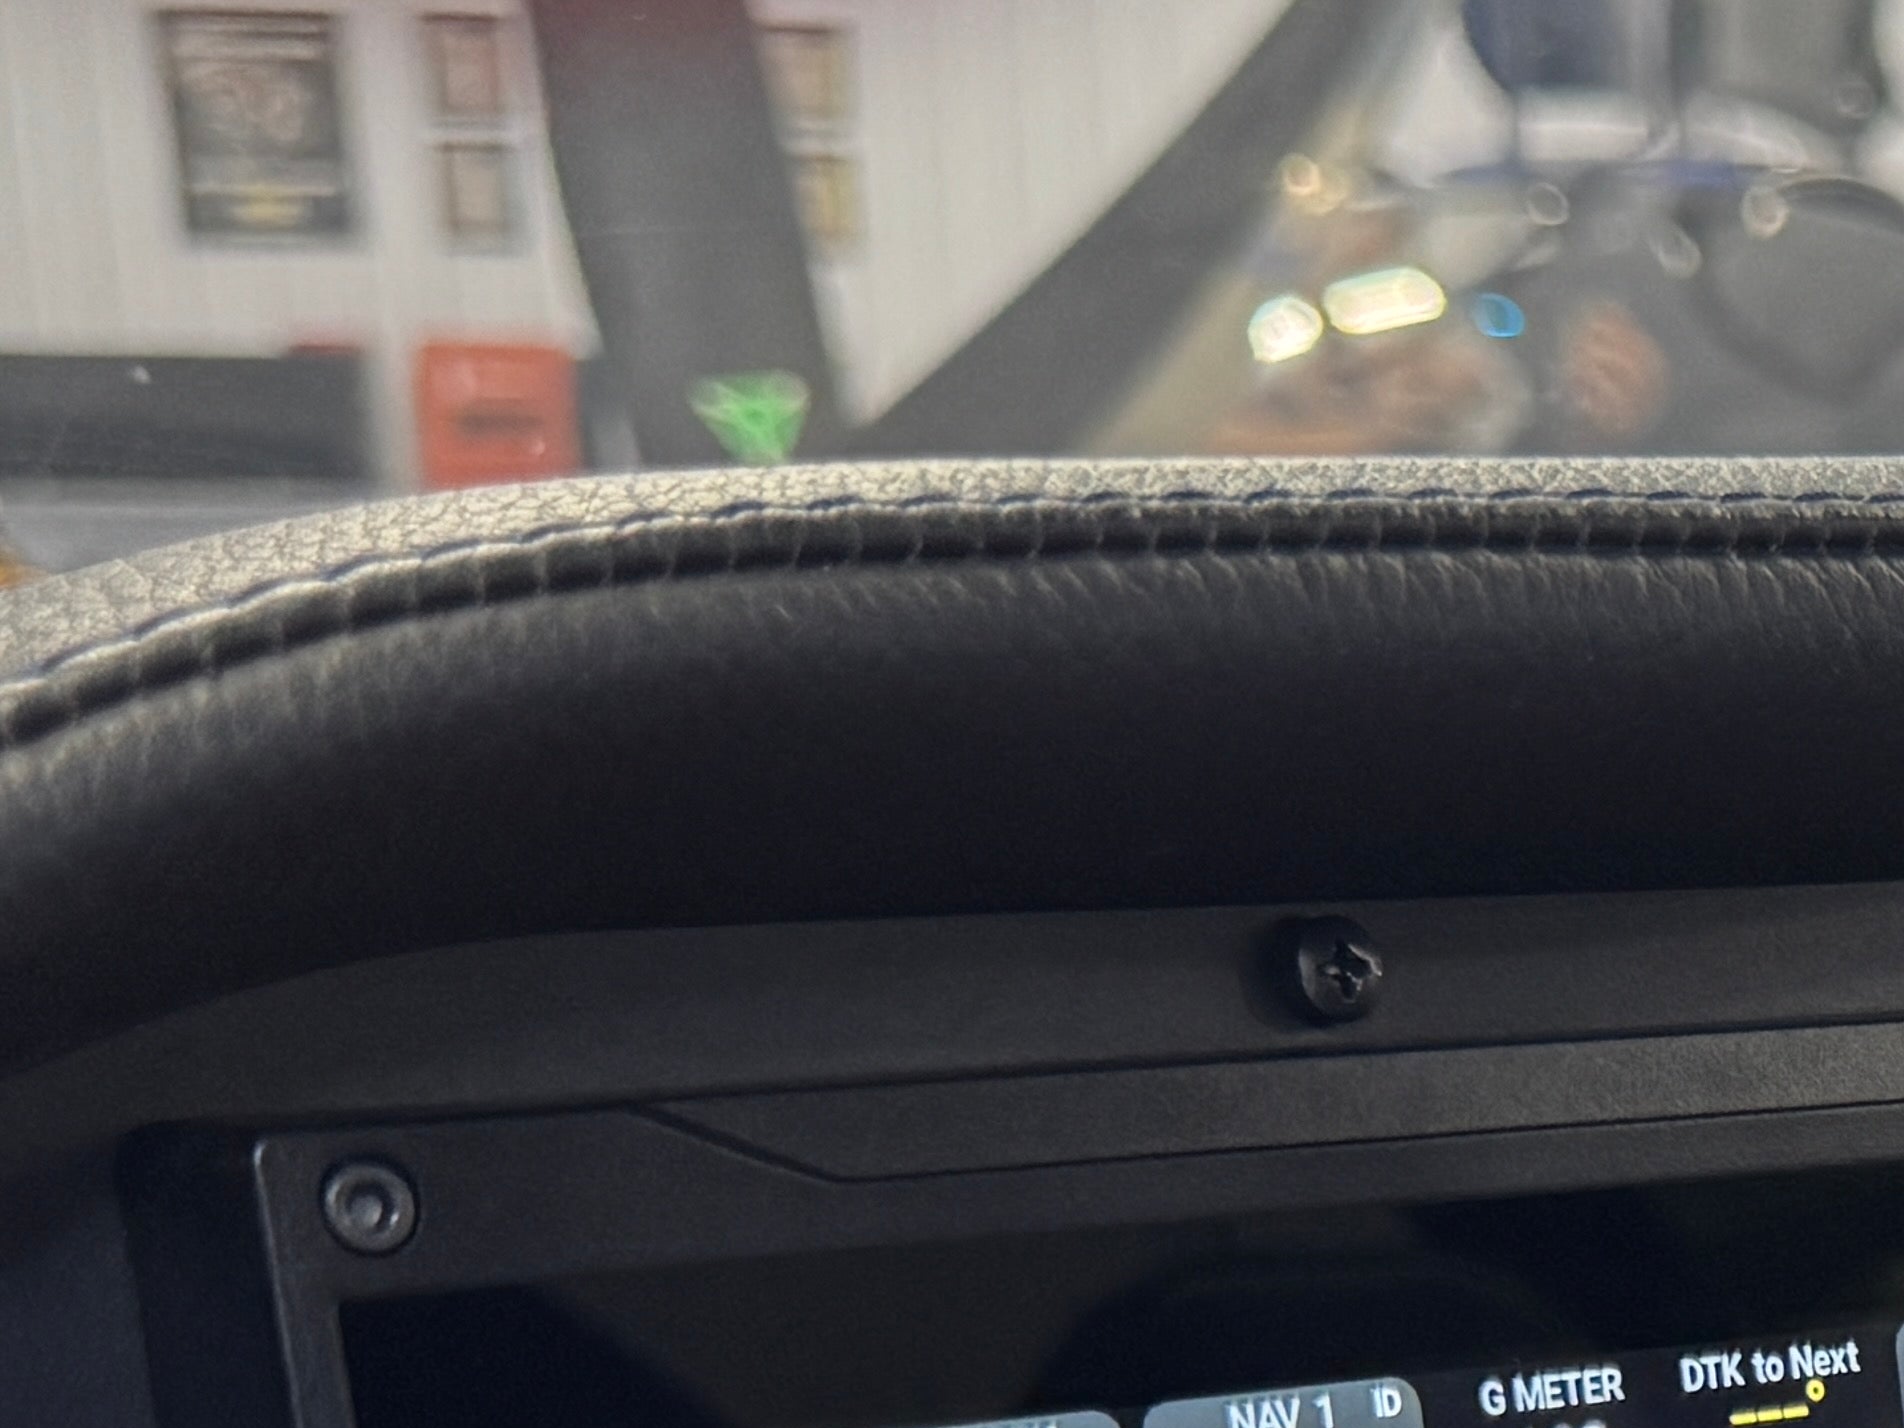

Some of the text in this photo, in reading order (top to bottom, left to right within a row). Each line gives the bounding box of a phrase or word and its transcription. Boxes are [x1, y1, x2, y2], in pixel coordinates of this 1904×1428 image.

[1680, 1339, 1860, 1393] DTK to Next
[1375, 1384, 1402, 1418] ID
[1479, 1369, 1625, 1417] G METER
